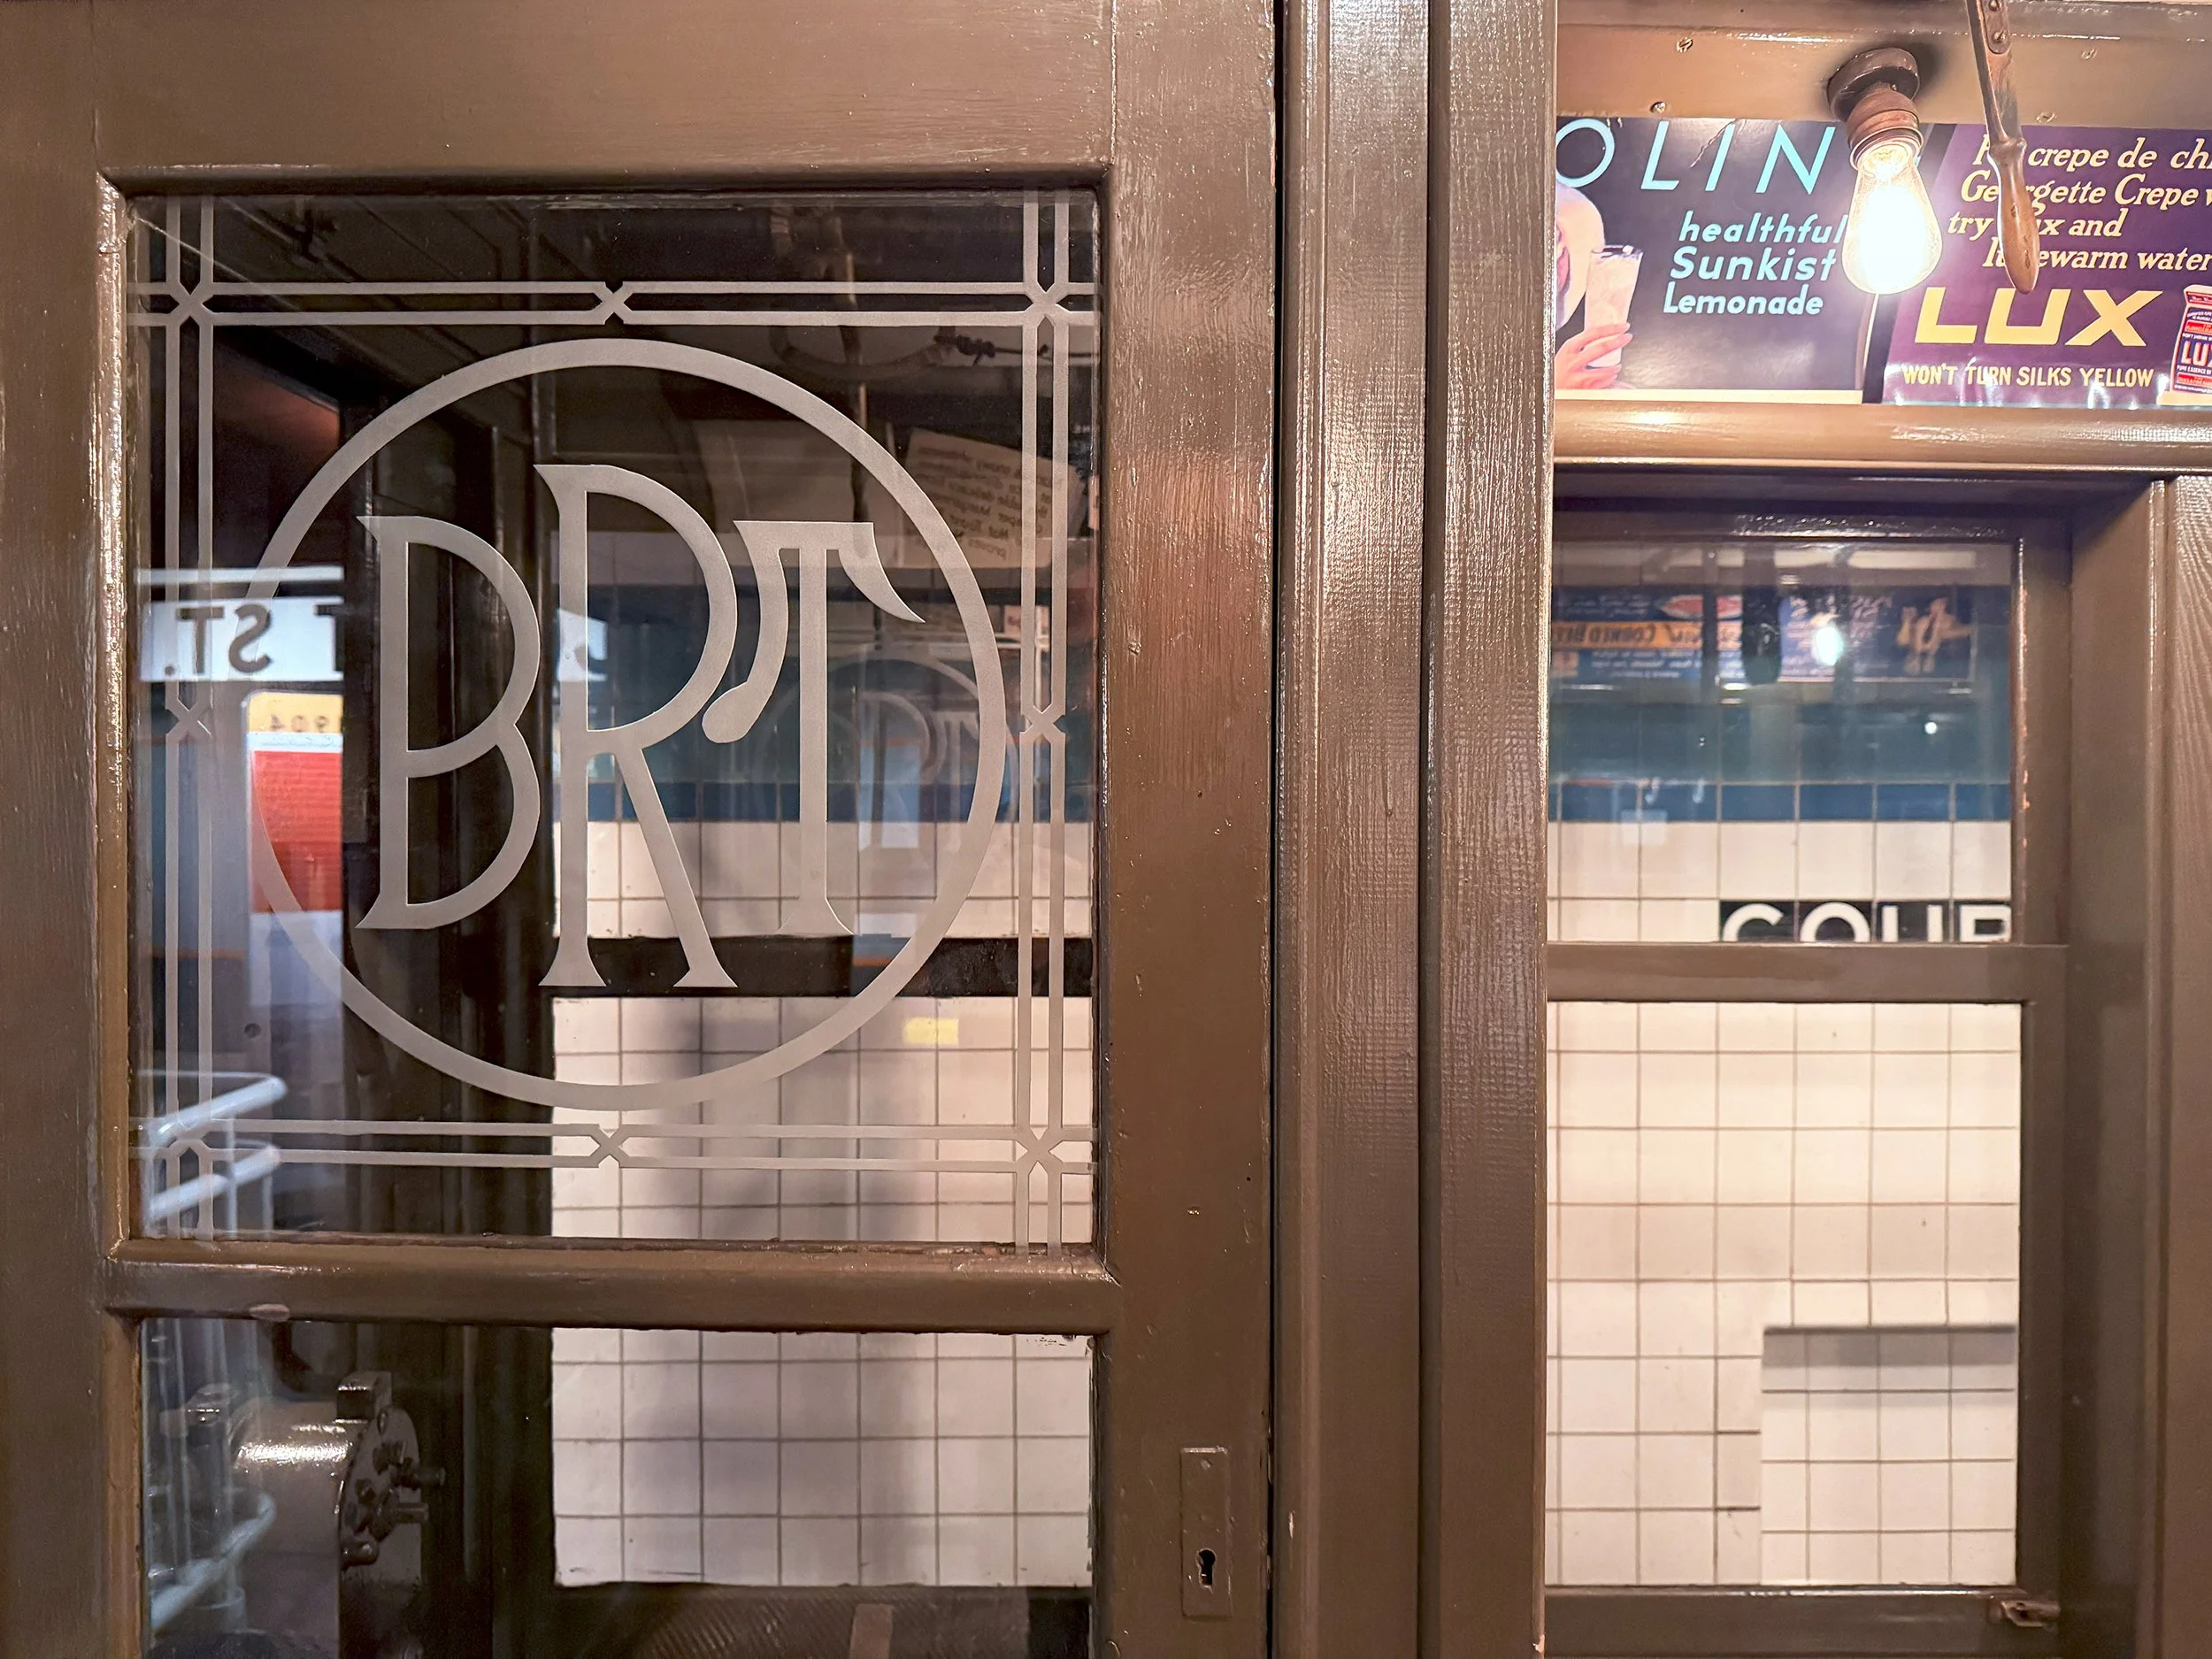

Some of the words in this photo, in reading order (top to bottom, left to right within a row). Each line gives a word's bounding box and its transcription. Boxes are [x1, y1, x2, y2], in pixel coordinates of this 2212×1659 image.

[1555, 118, 1836, 195] OLIN
[2028, 146, 2108, 173] crepe
[2117, 136, 2157, 168] de
[1961, 170, 2107, 216] Gegette
[2115, 173, 2199, 210] Crepe
[1678, 210, 1848, 243] healthful
[1947, 211, 1993, 241] try
[2069, 208, 2129, 237] and
[1670, 246, 1837, 281] Sunkist
[1982, 237, 2128, 270] luewarm
[2137, 248, 2212, 271] water
[1663, 281, 1824, 315] Lemonade
[1914, 287, 2163, 346] LUX
[1901, 363, 1958, 385] WON'T
[1966, 365, 2011, 386] TURN
[2016, 365, 2072, 387] SILKS
[2079, 367, 2154, 388] YELLOW
[355, 464, 926, 988] BRT
